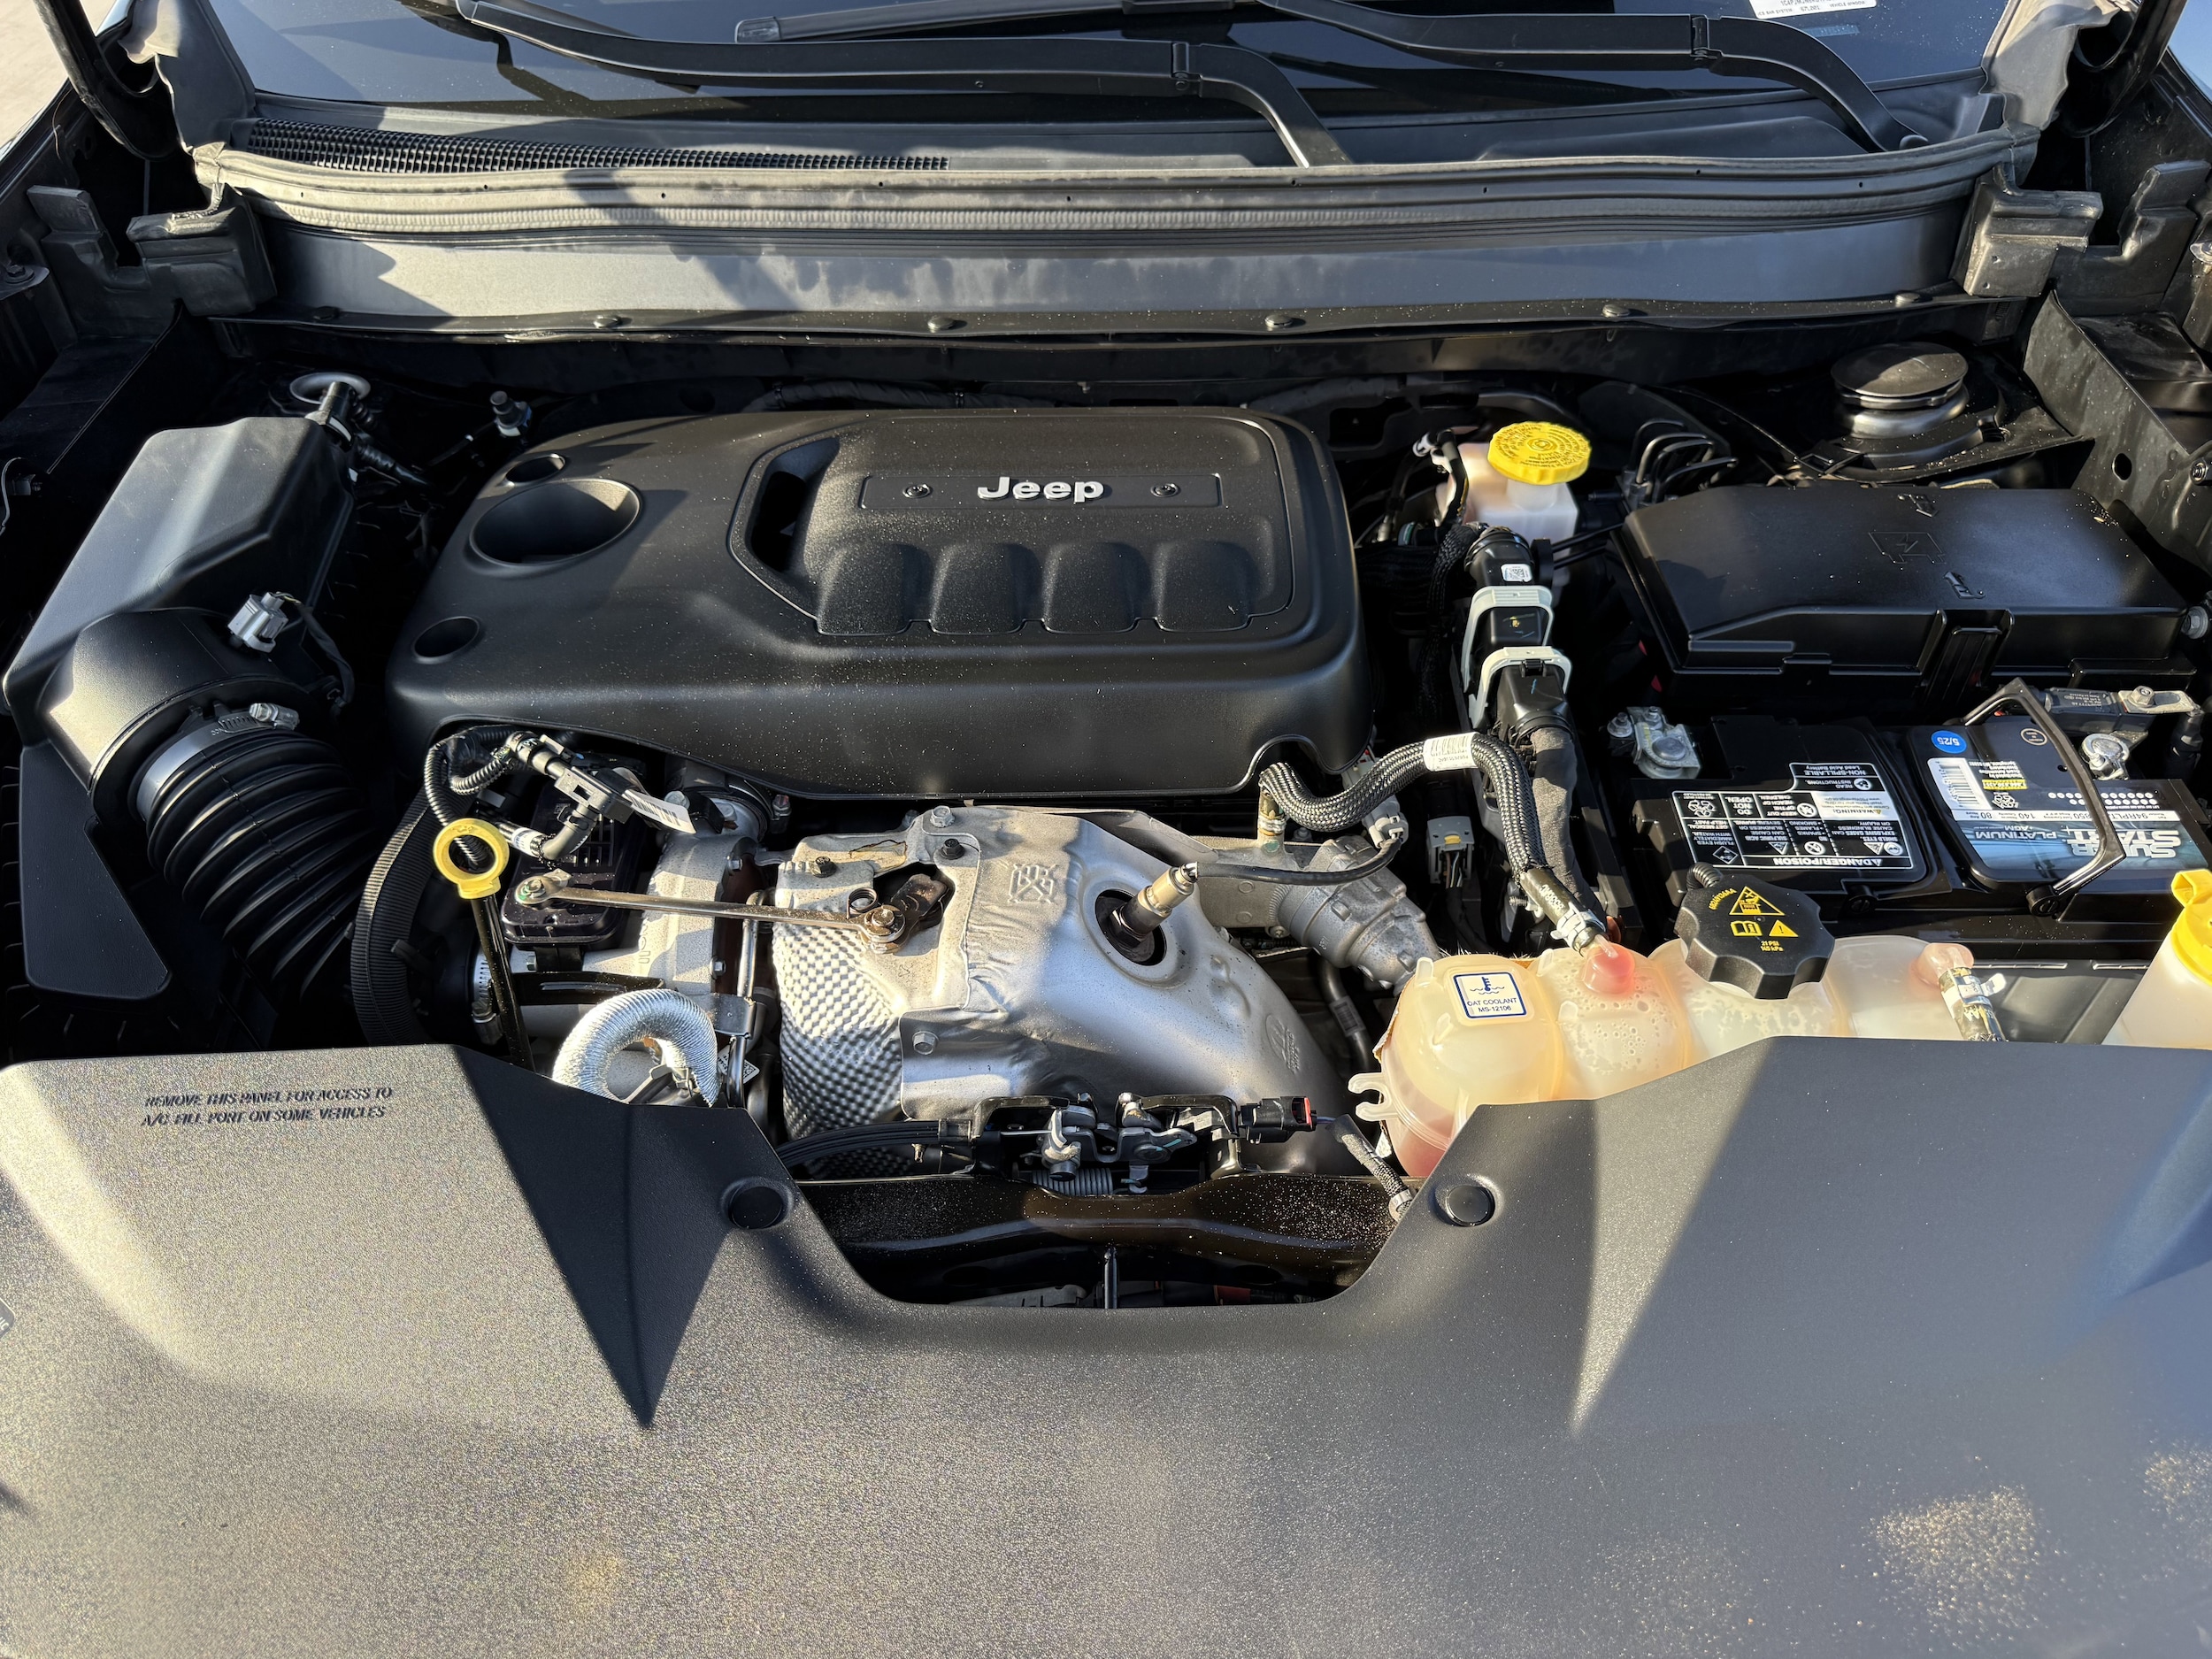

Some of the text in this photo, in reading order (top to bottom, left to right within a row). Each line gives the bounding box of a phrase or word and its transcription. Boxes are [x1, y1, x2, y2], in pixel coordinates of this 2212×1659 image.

[978, 476, 1104, 503] Jeep
[1937, 737, 1960, 746] 5/25
[1975, 831, 2057, 840] PLATINUM
[1483, 997, 1517, 1006] COOLANT
[1478, 1005, 1512, 1014] MS-12106
[145, 1087, 394, 1107] REMOVE THIS PANEL FOR ACCESS TO
[142, 1106, 387, 1126] A/C FILL PORT ON SOME VEHICLES
